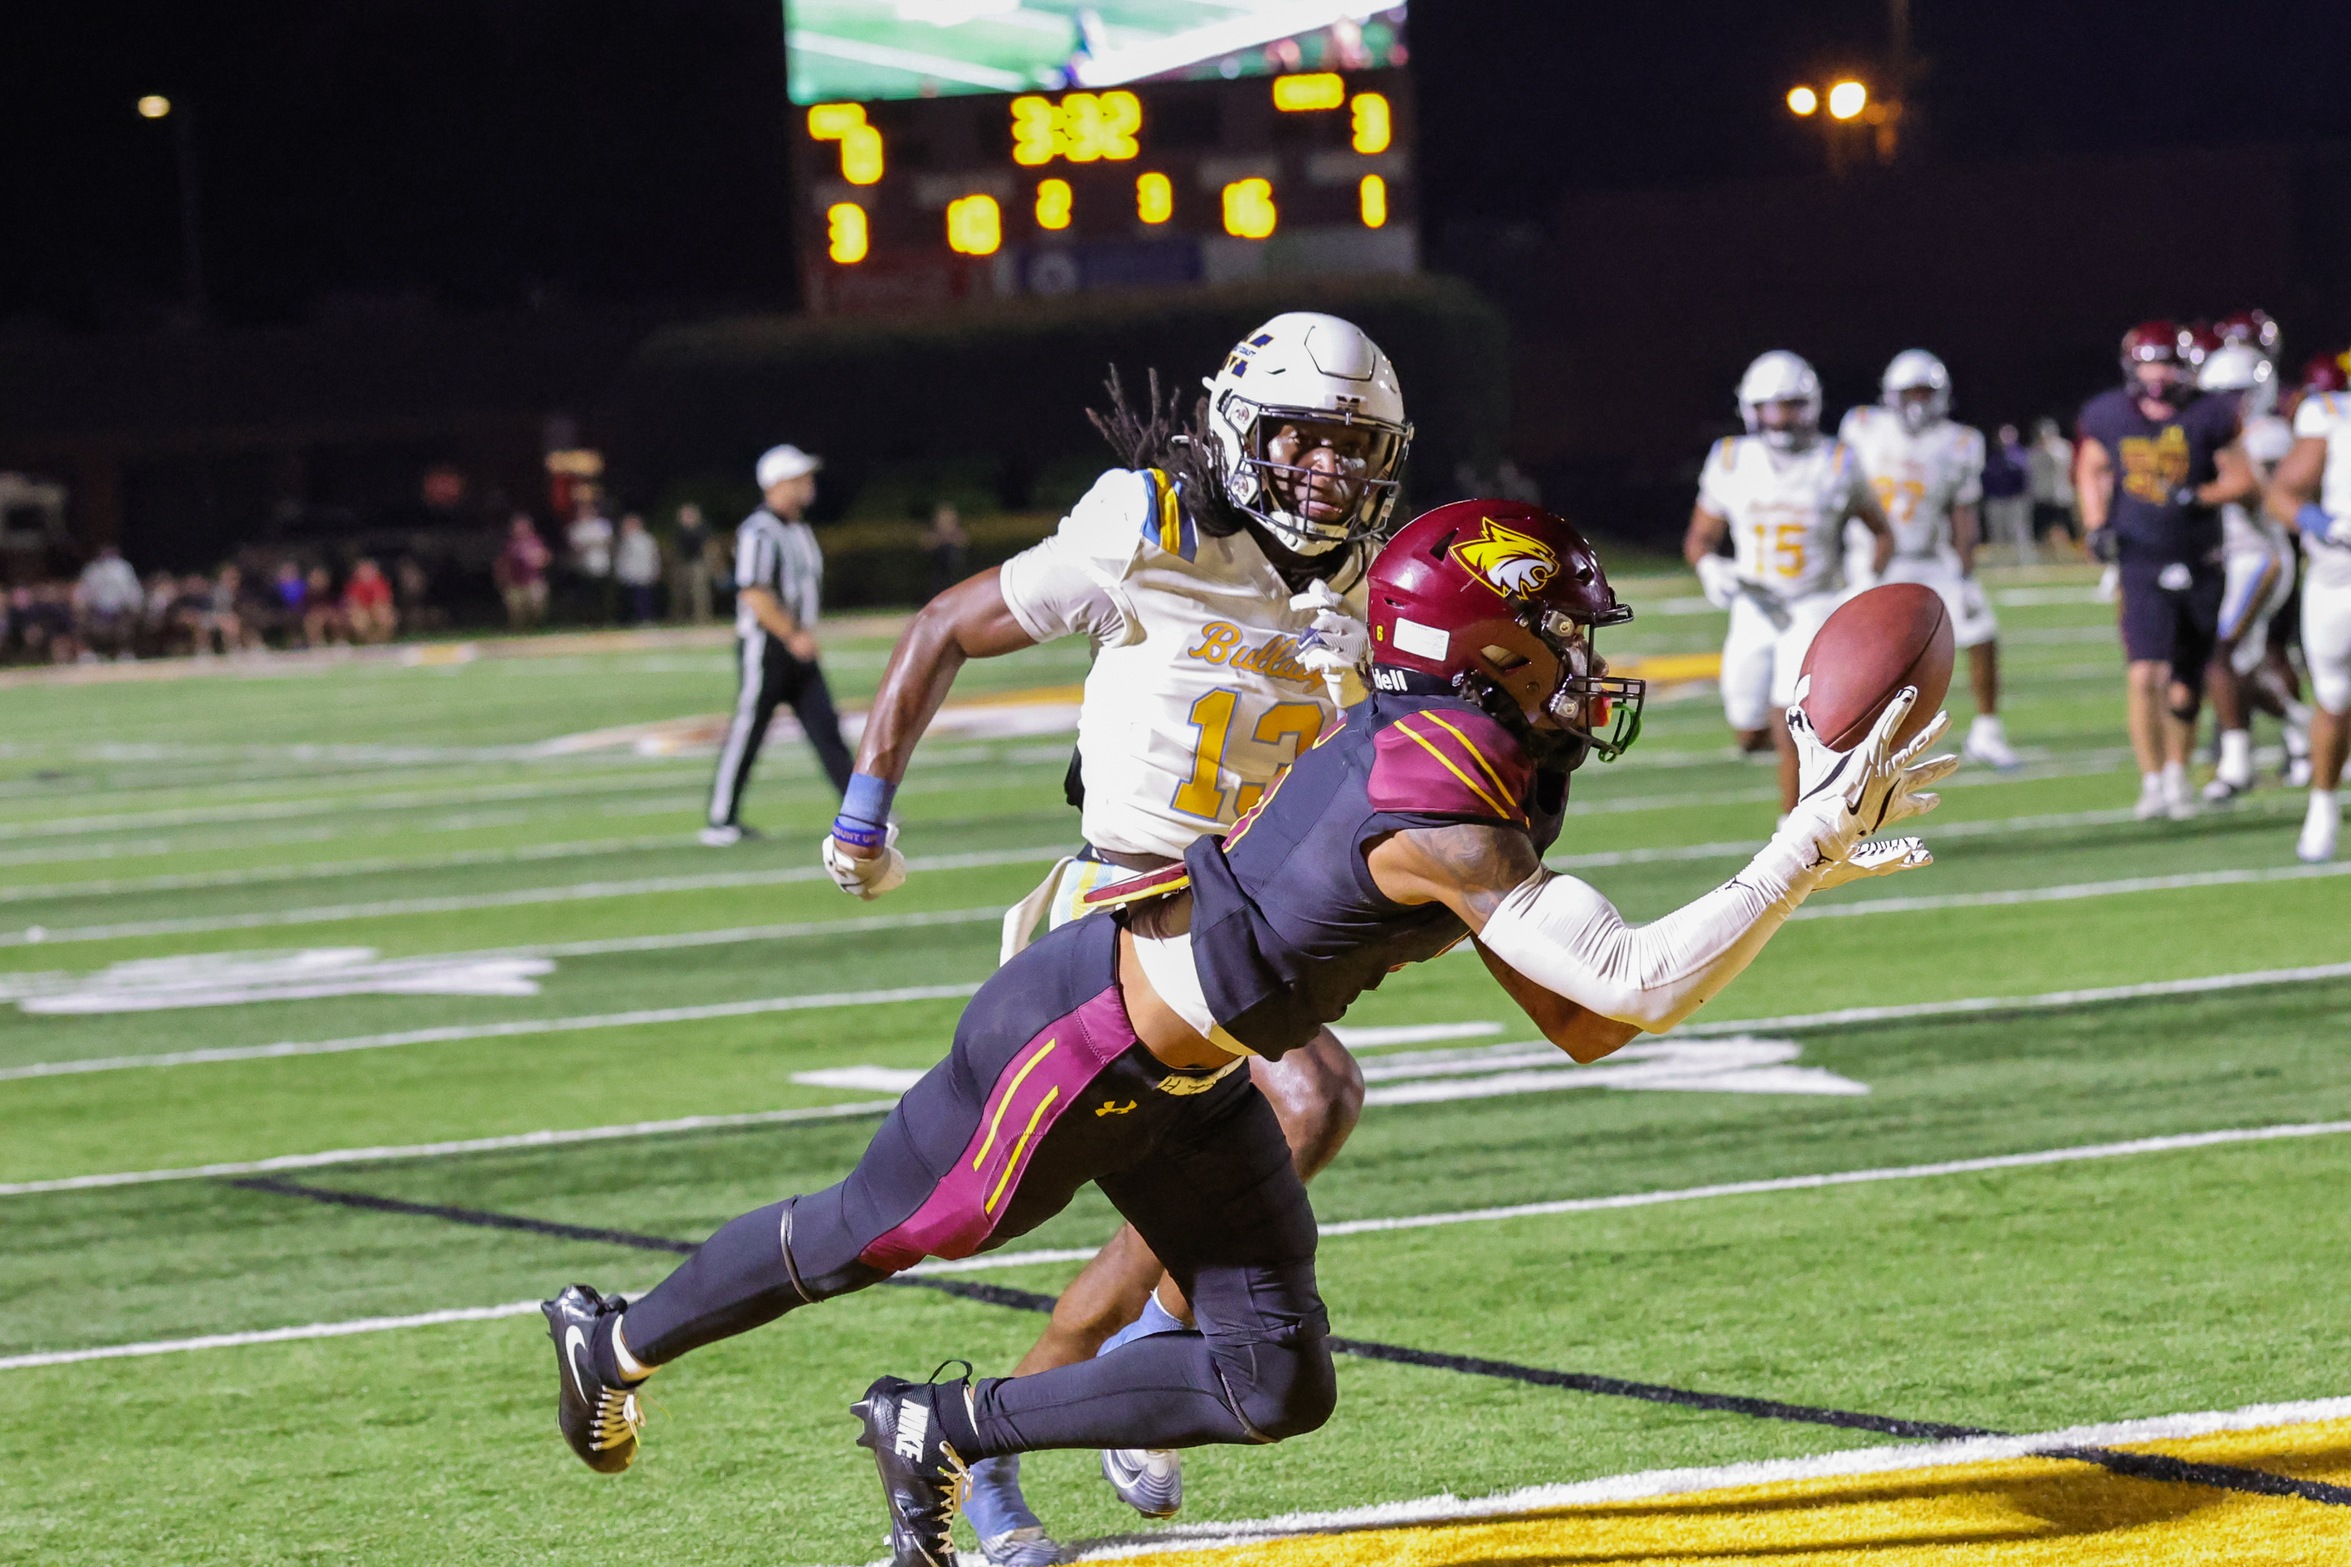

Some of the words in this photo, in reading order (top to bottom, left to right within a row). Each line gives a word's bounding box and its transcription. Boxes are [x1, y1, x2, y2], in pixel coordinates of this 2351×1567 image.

[1753, 523, 1808, 578] 15
[1376, 625, 1384, 642] 6
[894, 1398, 930, 1464] NIKE
